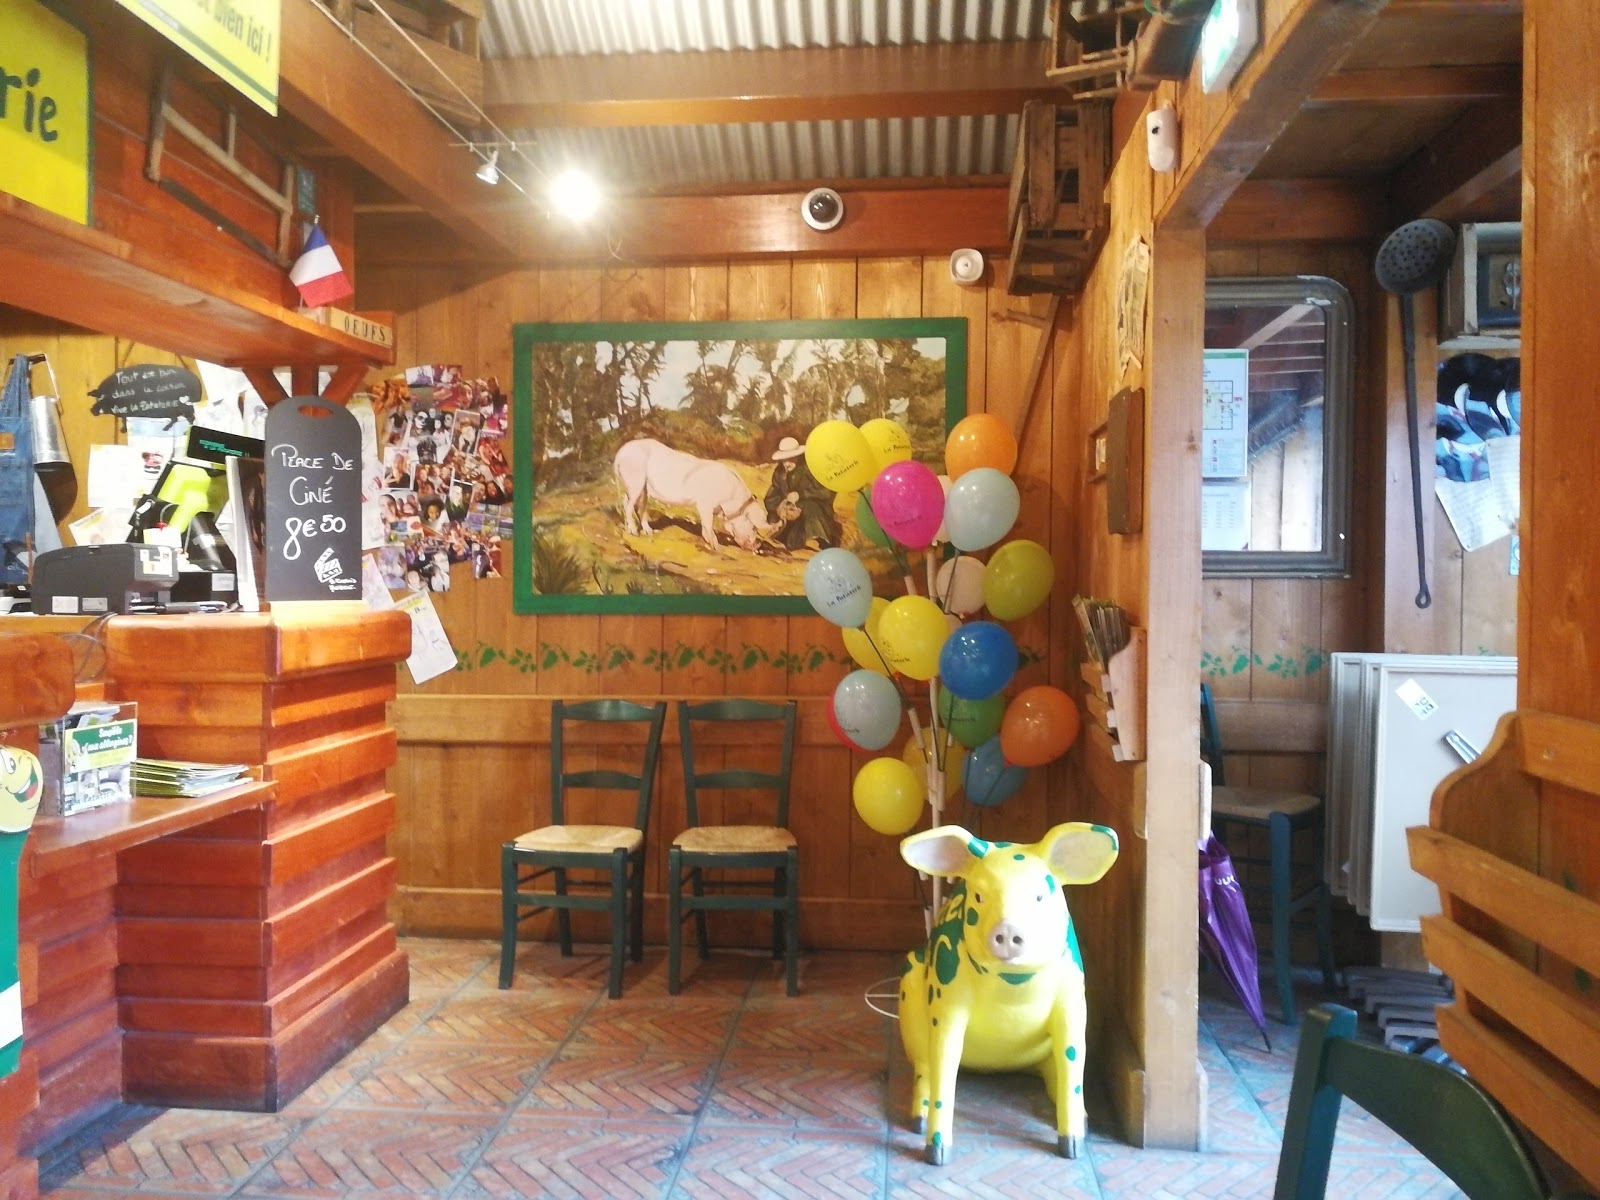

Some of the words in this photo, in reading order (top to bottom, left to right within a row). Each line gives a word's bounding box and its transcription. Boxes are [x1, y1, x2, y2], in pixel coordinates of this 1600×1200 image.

[247, 16, 264, 56] ici
[344, 316, 386, 342] OEUFS
[116, 371, 139, 385] Tout
[112, 388, 136, 399] dans
